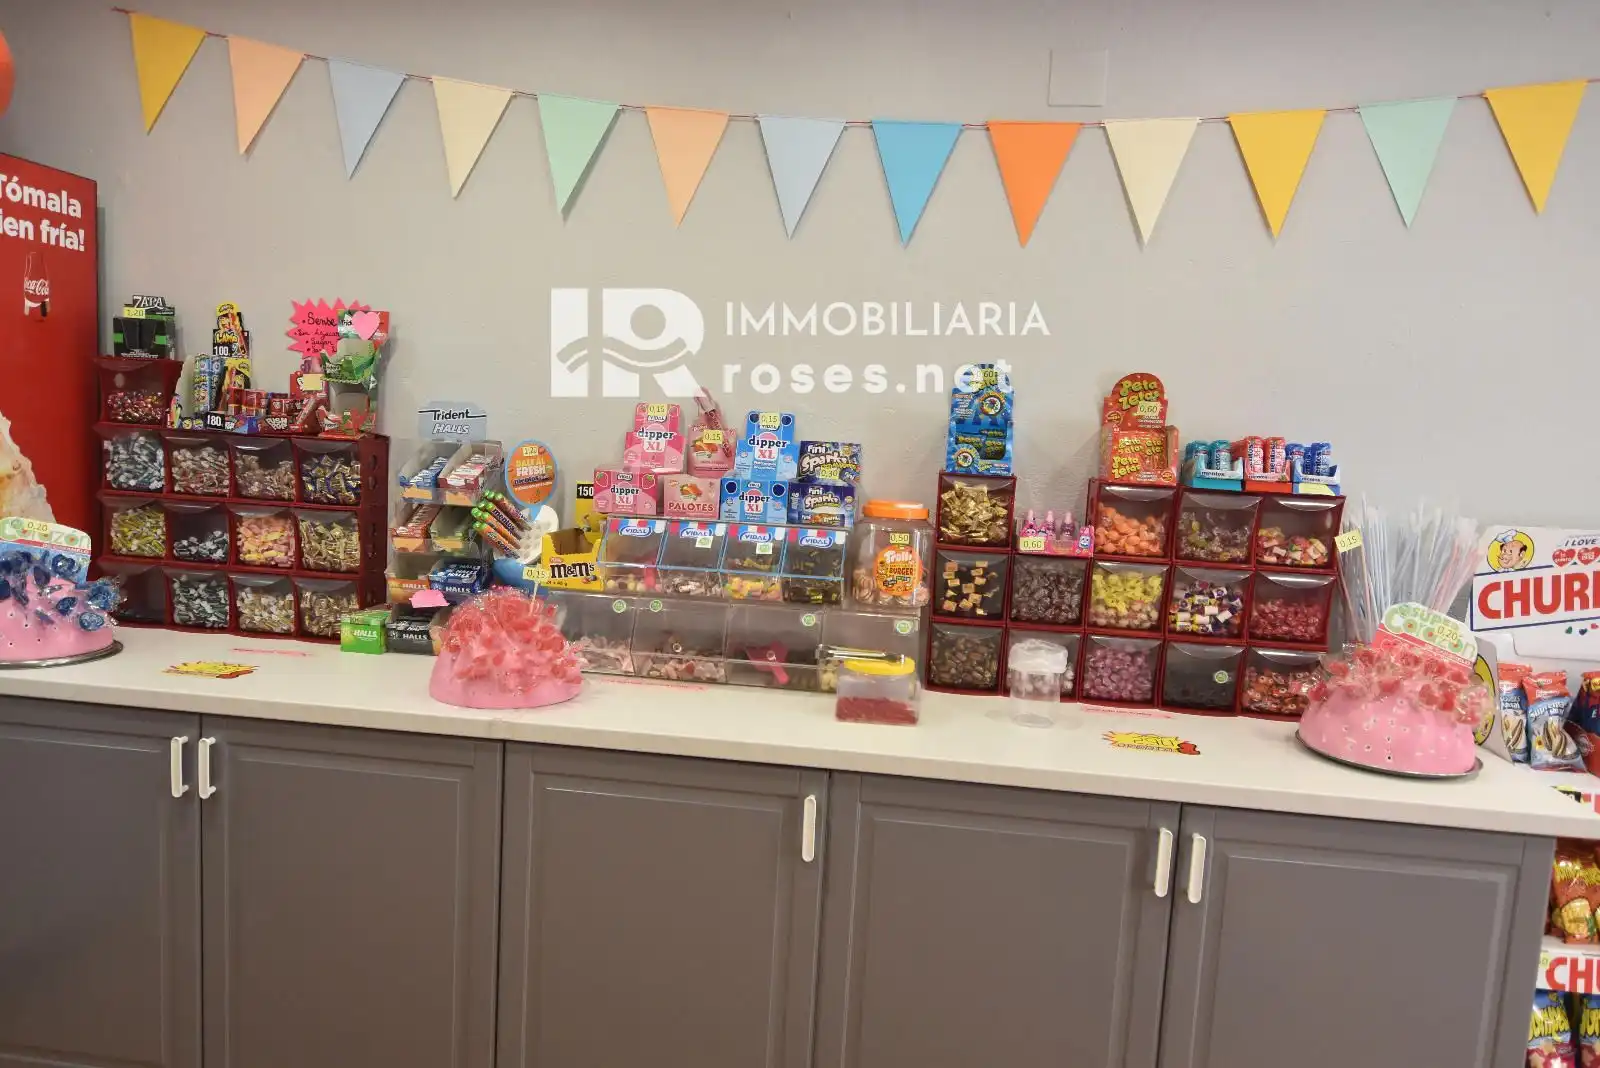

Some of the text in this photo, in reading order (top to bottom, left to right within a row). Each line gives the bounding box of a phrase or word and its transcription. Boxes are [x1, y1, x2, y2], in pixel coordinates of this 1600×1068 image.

[40, 219, 84, 251] fría!
[1120, 380, 1158, 397] Peta
[649, 405, 665, 413] 0,15
[1139, 404, 1158, 414] 0,60
[418, 409, 487, 421] Trident
[761, 414, 778, 424] 0,15
[207, 415, 221, 426] 180
[432, 423, 469, 434] HALLS
[637, 427, 675, 441] dipper
[704, 432, 721, 441] 0,15
[645, 441, 663, 451] XL
[748, 435, 787, 449] dipper
[757, 449, 776, 460] XL
[1112, 455, 1139, 469] Peta
[577, 486, 594, 497] 150
[610, 485, 640, 497] dipper
[618, 496, 632, 505] XL
[738, 492, 770, 505] dipper
[668, 502, 714, 512] PALOTES
[746, 503, 762, 513] XL
[27, 521, 48, 532] 0,20
[624, 527, 648, 535] VIDAL
[685, 529, 708, 537] VIDAL
[744, 533, 768, 541] VIDAL
[890, 534, 909, 542] 0,50
[805, 538, 829, 546] VIDAL
[1023, 540, 1042, 549] 0,60
[1571, 538, 1597, 547] LOVE
[353, 629, 378, 638] HALLS
[1437, 625, 1458, 640] 0,20
[1545, 956, 1600, 994] CH
